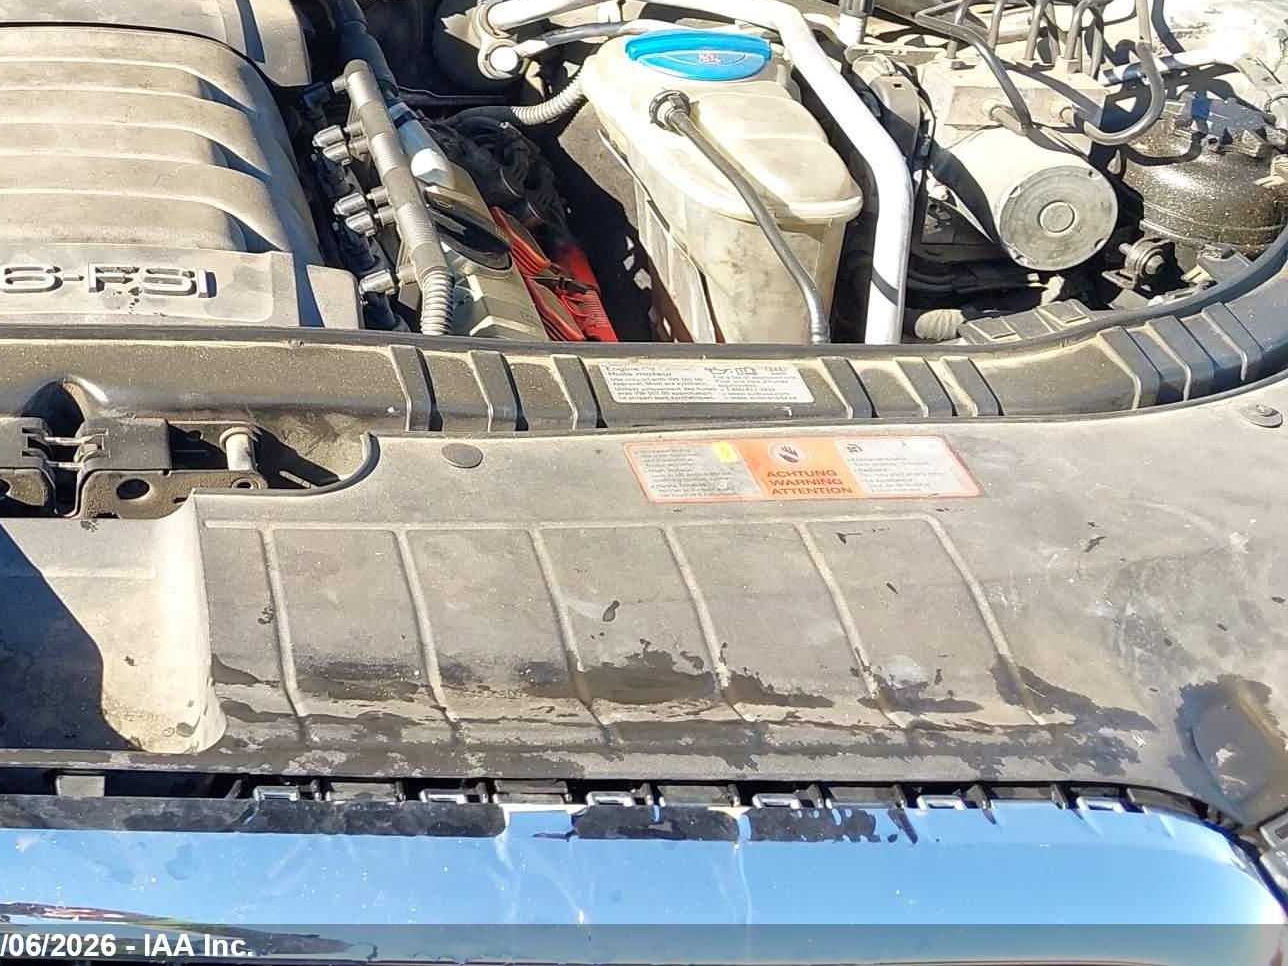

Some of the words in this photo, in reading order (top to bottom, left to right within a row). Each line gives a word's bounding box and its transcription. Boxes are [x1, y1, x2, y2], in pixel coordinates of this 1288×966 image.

[767, 470, 838, 478] ACHTUNG
[768, 478, 844, 486] WARNING
[772, 487, 853, 495] ATTENTION
